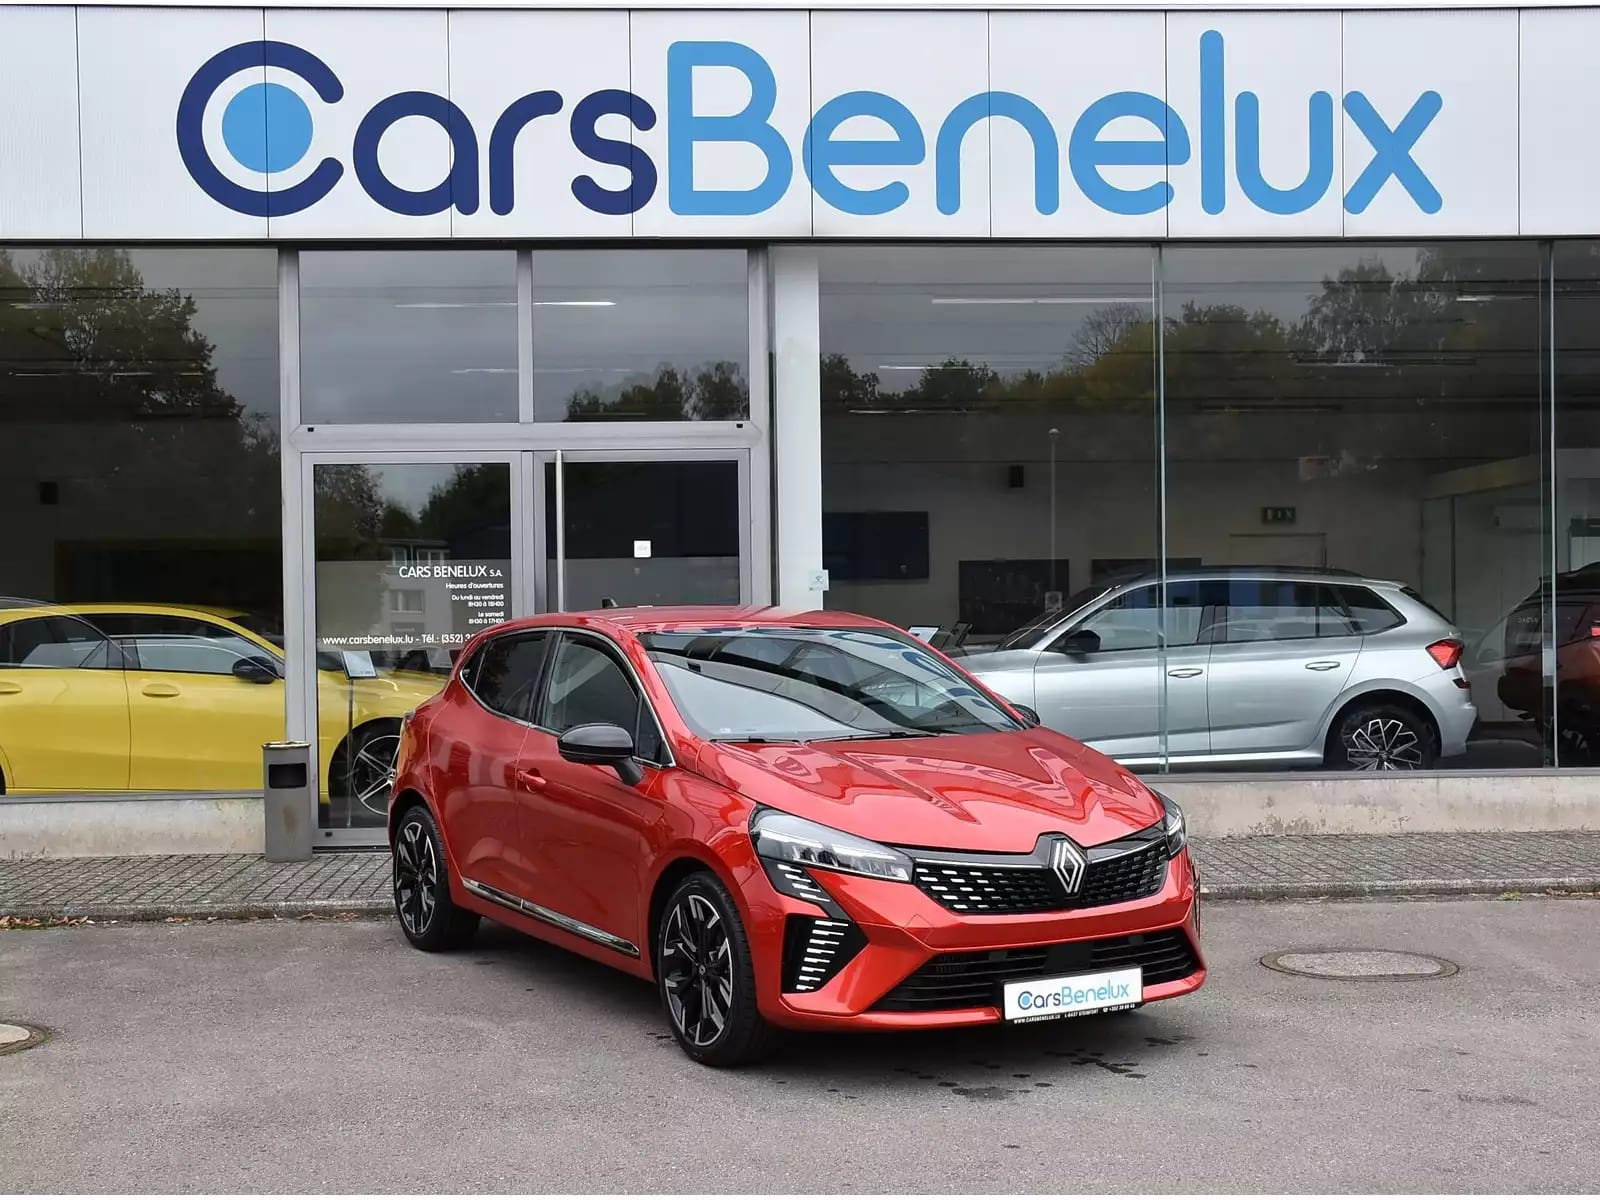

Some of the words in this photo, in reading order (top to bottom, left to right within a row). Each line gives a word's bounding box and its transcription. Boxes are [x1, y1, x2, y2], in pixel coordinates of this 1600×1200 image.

[177, 30, 1443, 216] CarsBenelux
[399, 566, 431, 578] CARS
[433, 565, 487, 578] BENELUX
[322, 634, 414, 645] www.carsbenelux.lu
[441, 633, 463, 644] (352)
[1017, 979, 1130, 1010] CarsBenelux
